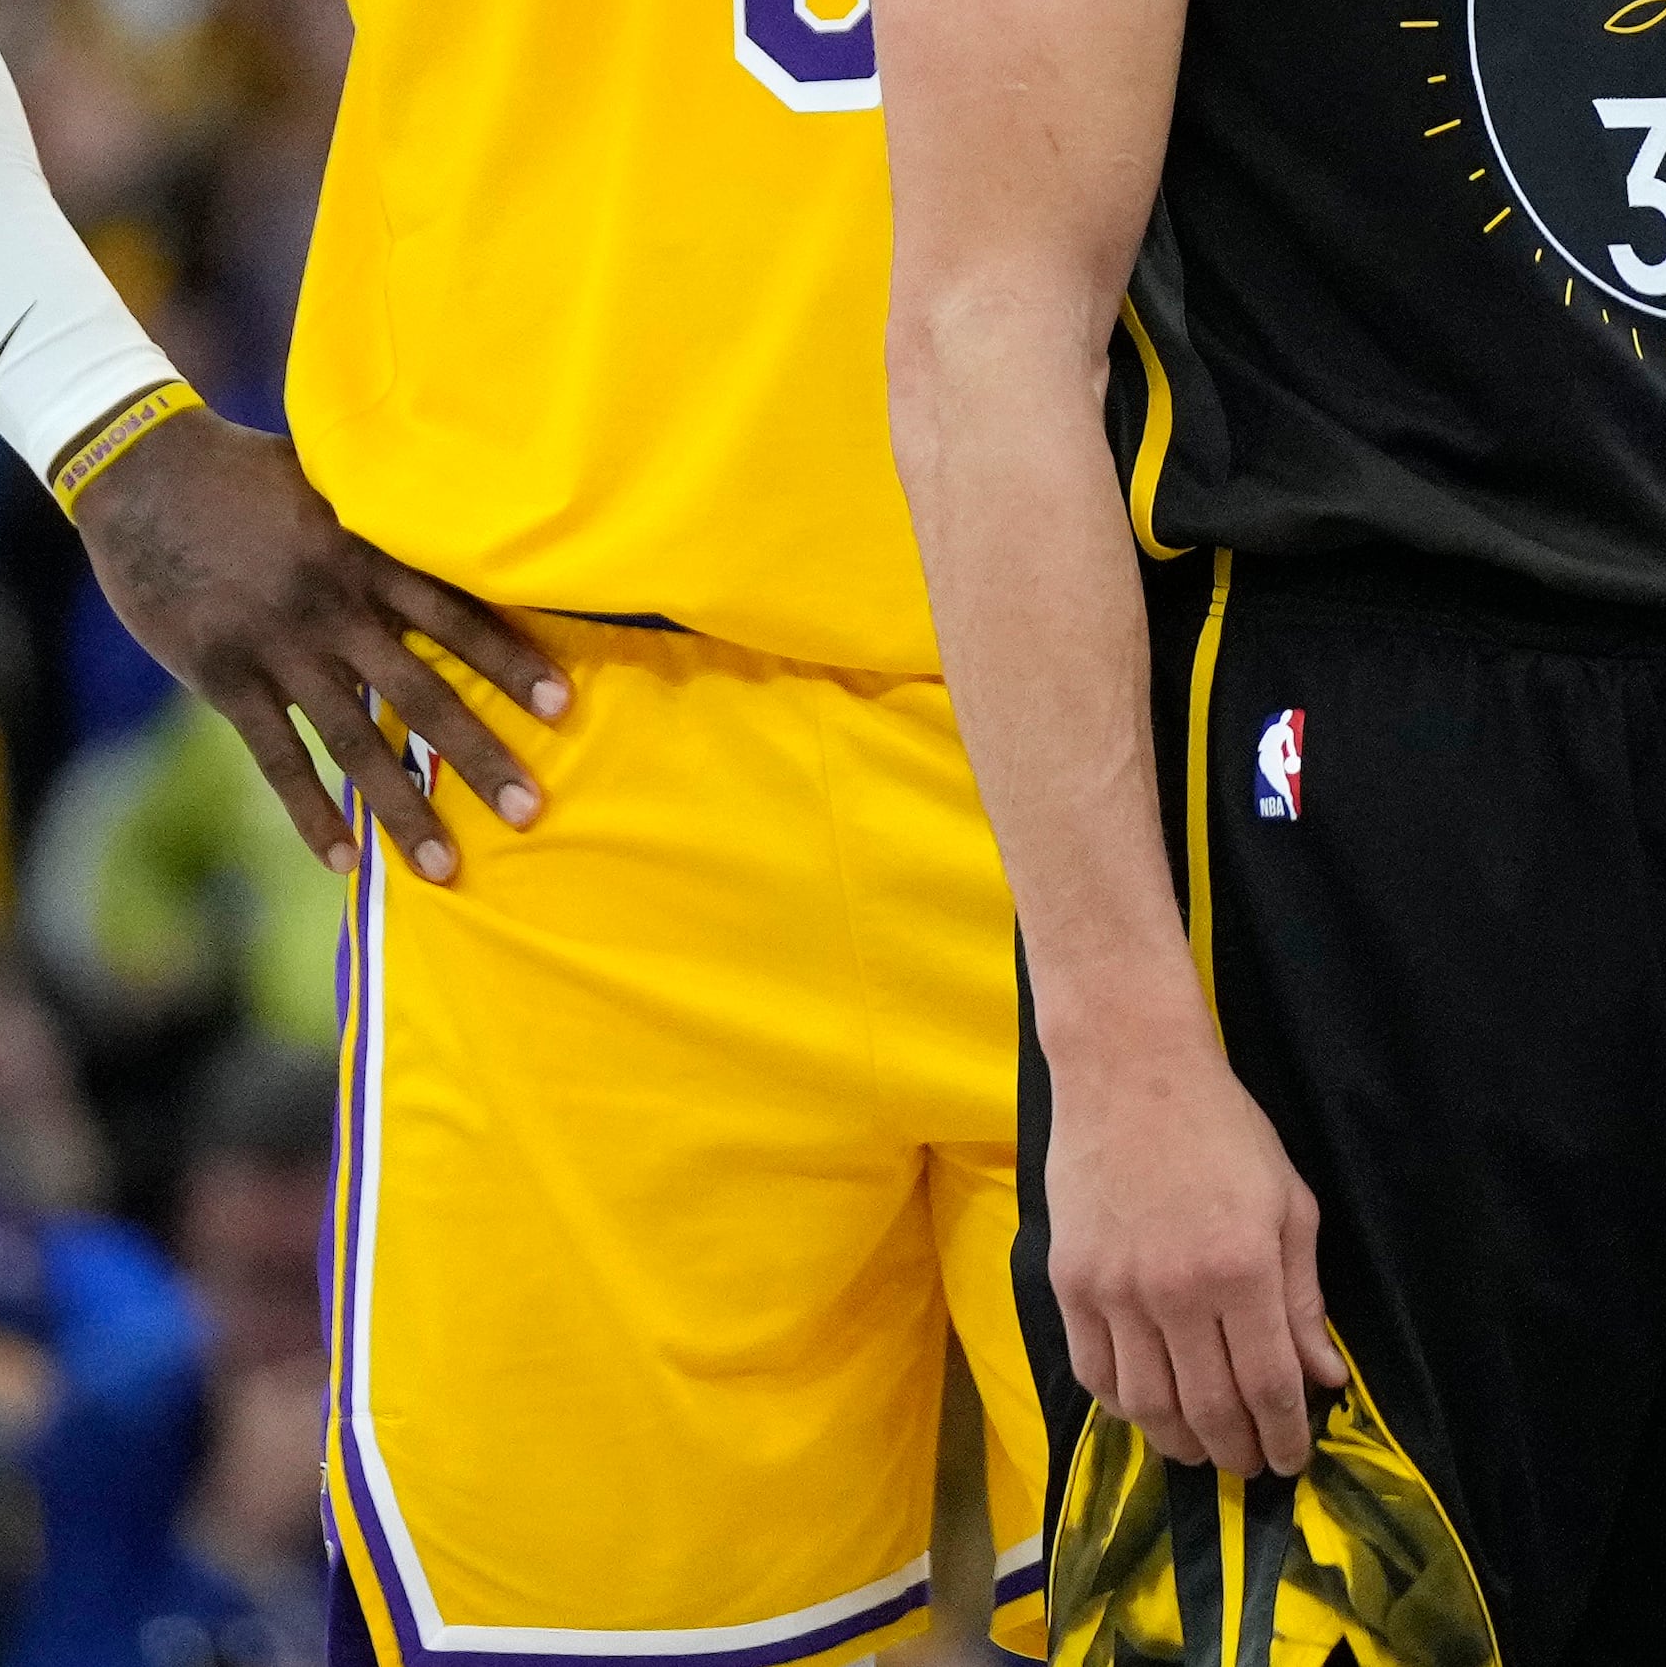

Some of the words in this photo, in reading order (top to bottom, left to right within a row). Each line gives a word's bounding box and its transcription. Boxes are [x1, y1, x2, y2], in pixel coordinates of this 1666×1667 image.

[155, 394, 170, 410] I
[61, 403, 157, 491] PROMISE
[1259, 795, 1286, 818] NBA
